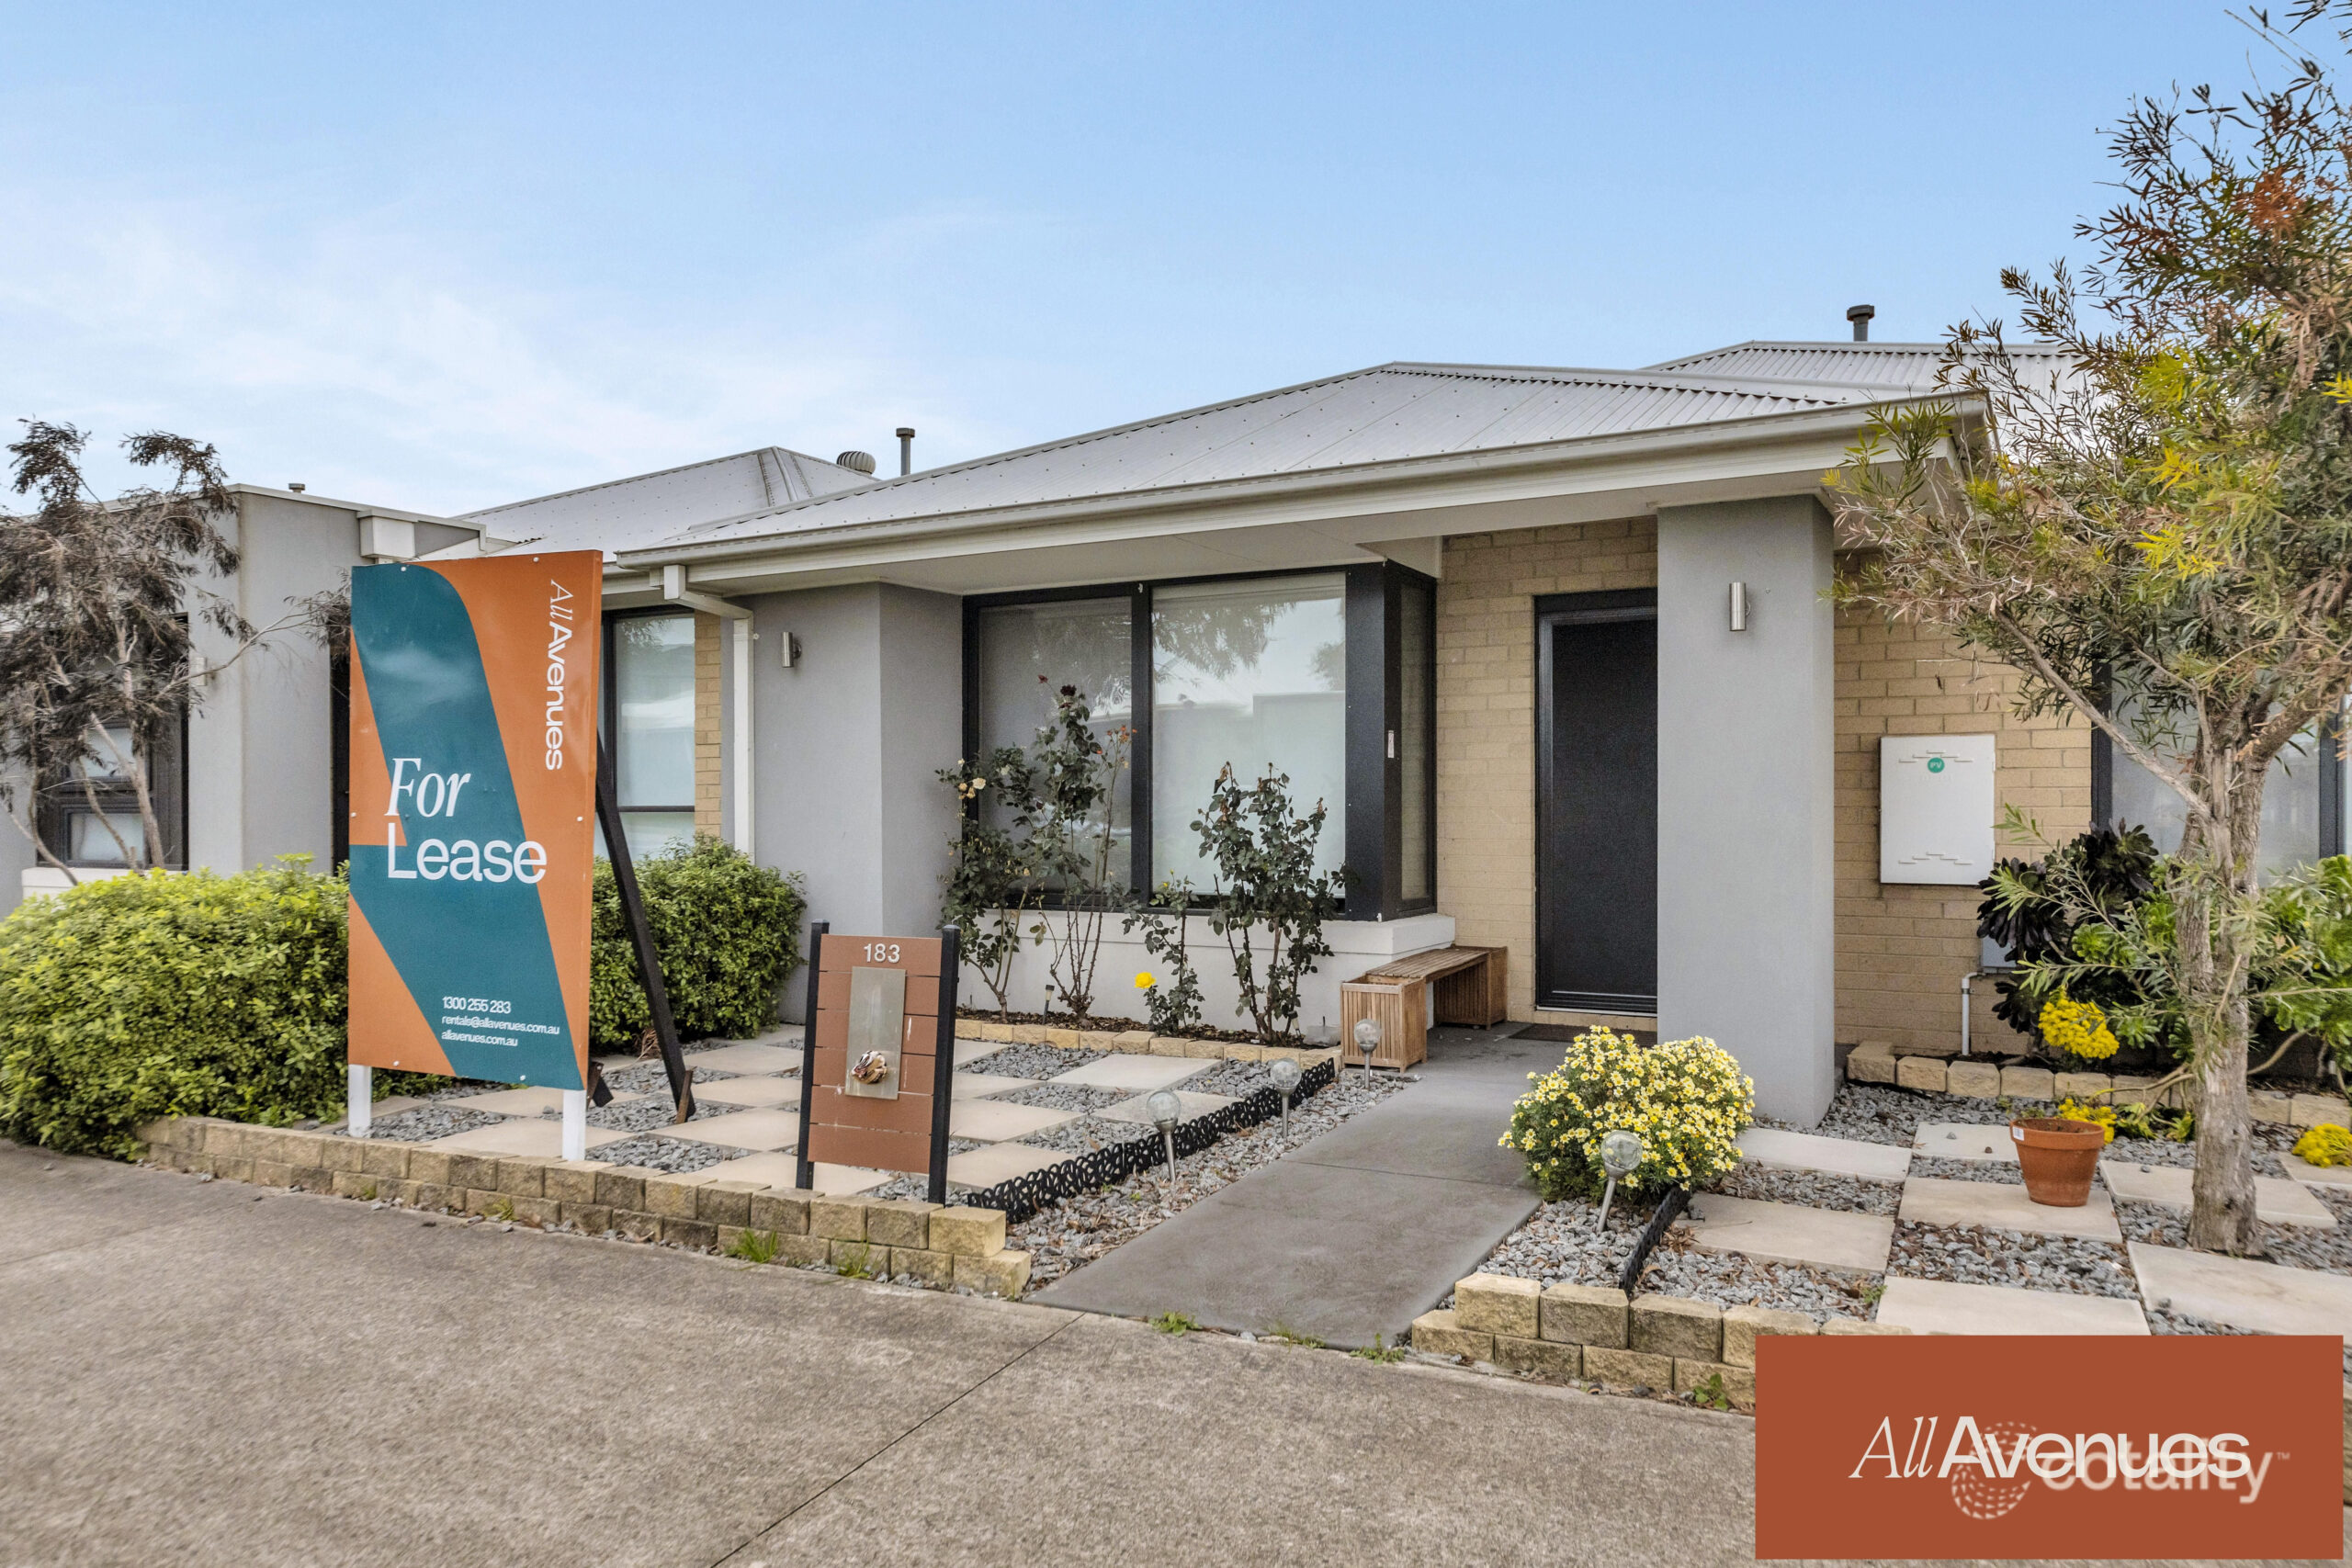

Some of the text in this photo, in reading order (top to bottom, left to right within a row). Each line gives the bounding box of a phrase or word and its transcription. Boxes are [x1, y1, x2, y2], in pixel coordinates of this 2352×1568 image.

[384, 758, 471, 818] For
[388, 822, 547, 884] Lease
[865, 942, 900, 963] 183
[442, 997, 511, 1013] 1300 255 283
[441, 1015, 560, 1034] rentals@allavenues.com.au
[441, 1030, 518, 1046] allavenues.com.au
